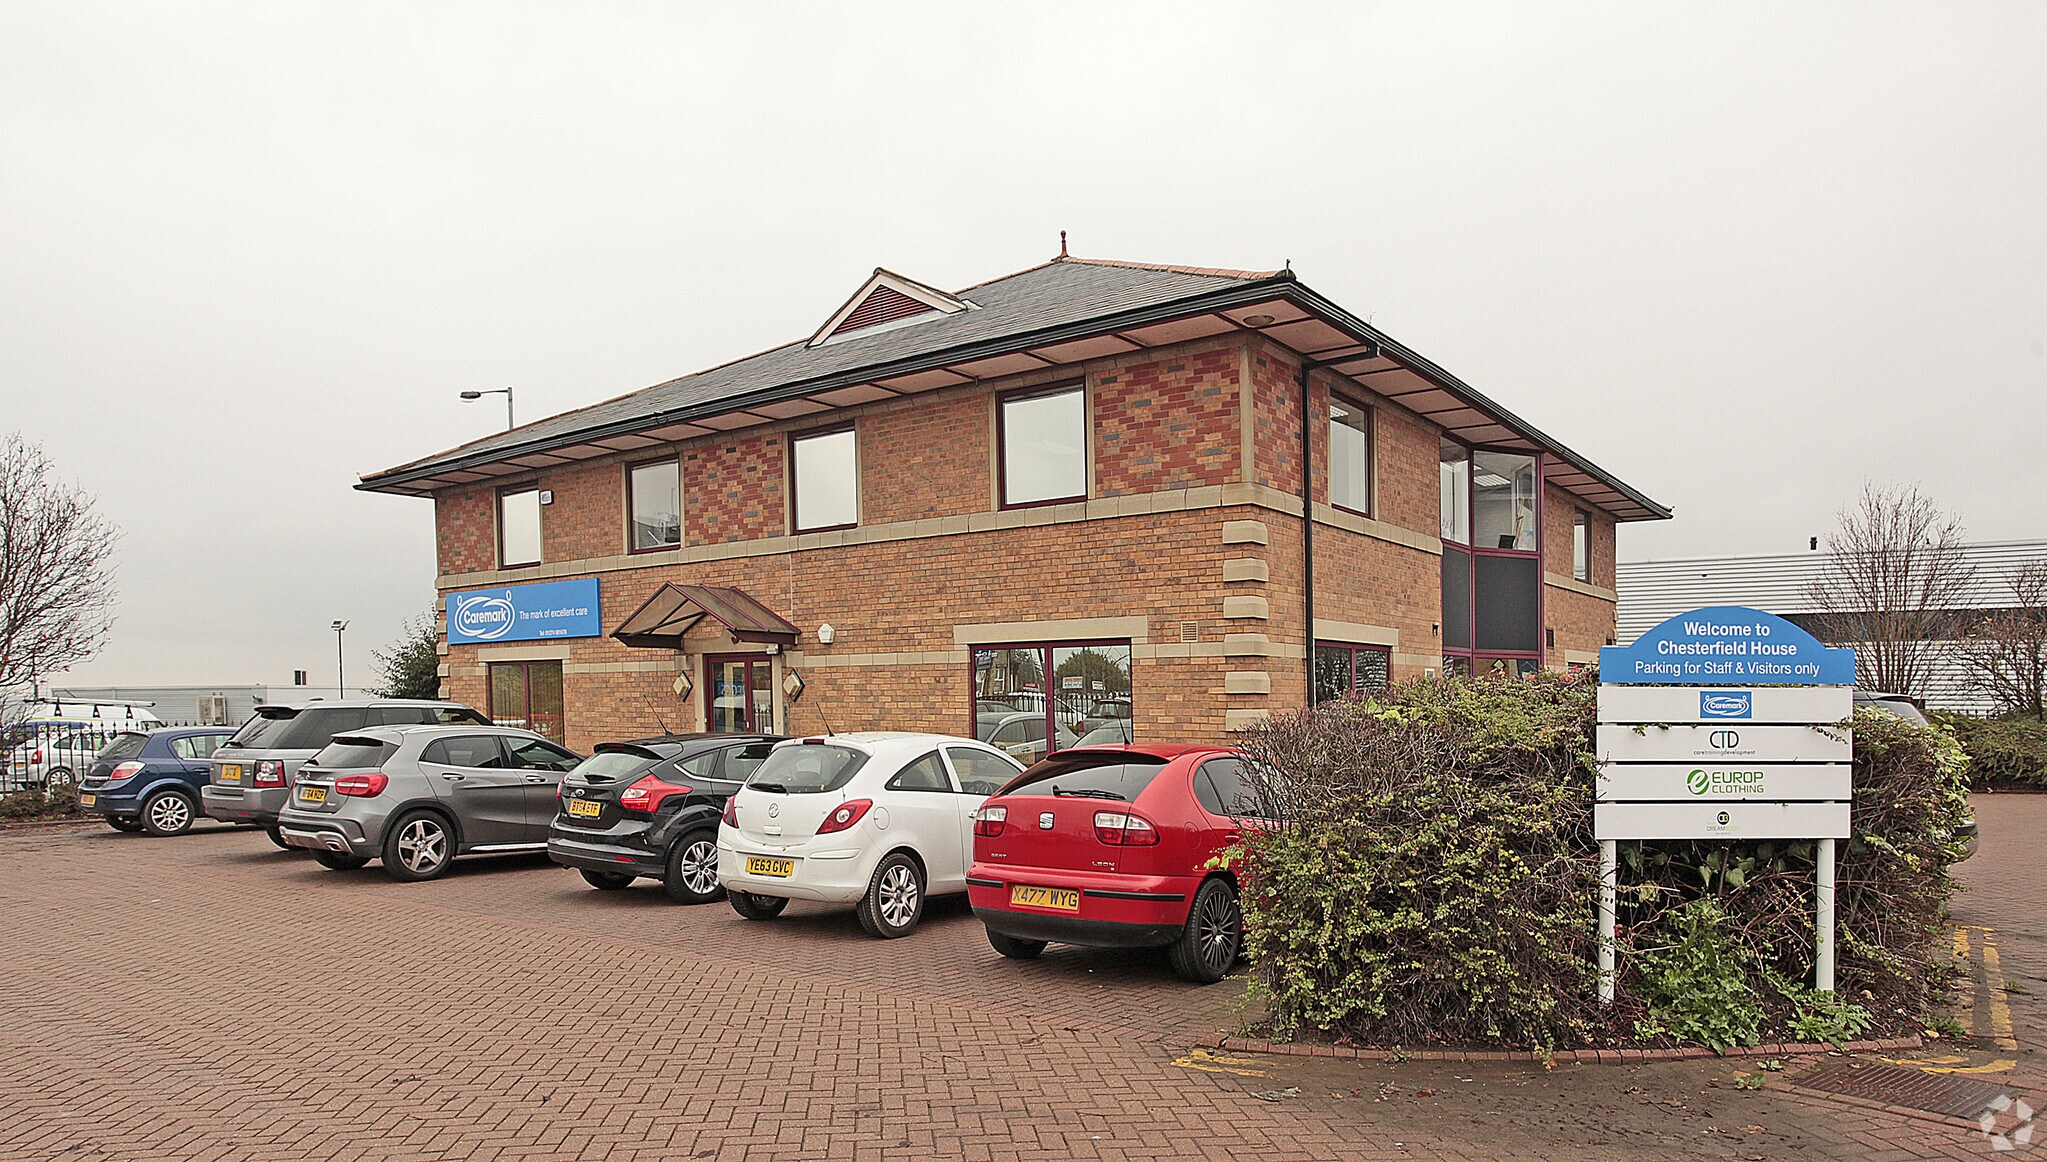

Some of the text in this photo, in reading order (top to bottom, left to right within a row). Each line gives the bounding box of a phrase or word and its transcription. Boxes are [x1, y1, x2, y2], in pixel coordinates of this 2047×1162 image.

[464, 607, 507, 624] Caremark
[519, 607, 588, 620] The mark of excellent care
[1684, 621, 1771, 637] Welcome to
[1657, 640, 1797, 656] Chesterfield House
[1635, 660, 1820, 678] Parking for Staff & Visitors only
[1709, 730, 1740, 749] CTD
[1712, 771, 1764, 783] EUROP
[1712, 785, 1764, 794] CLOTHING
[750, 859, 790, 874] YE63 GVC
[1013, 887, 1078, 907] X477 WYG
